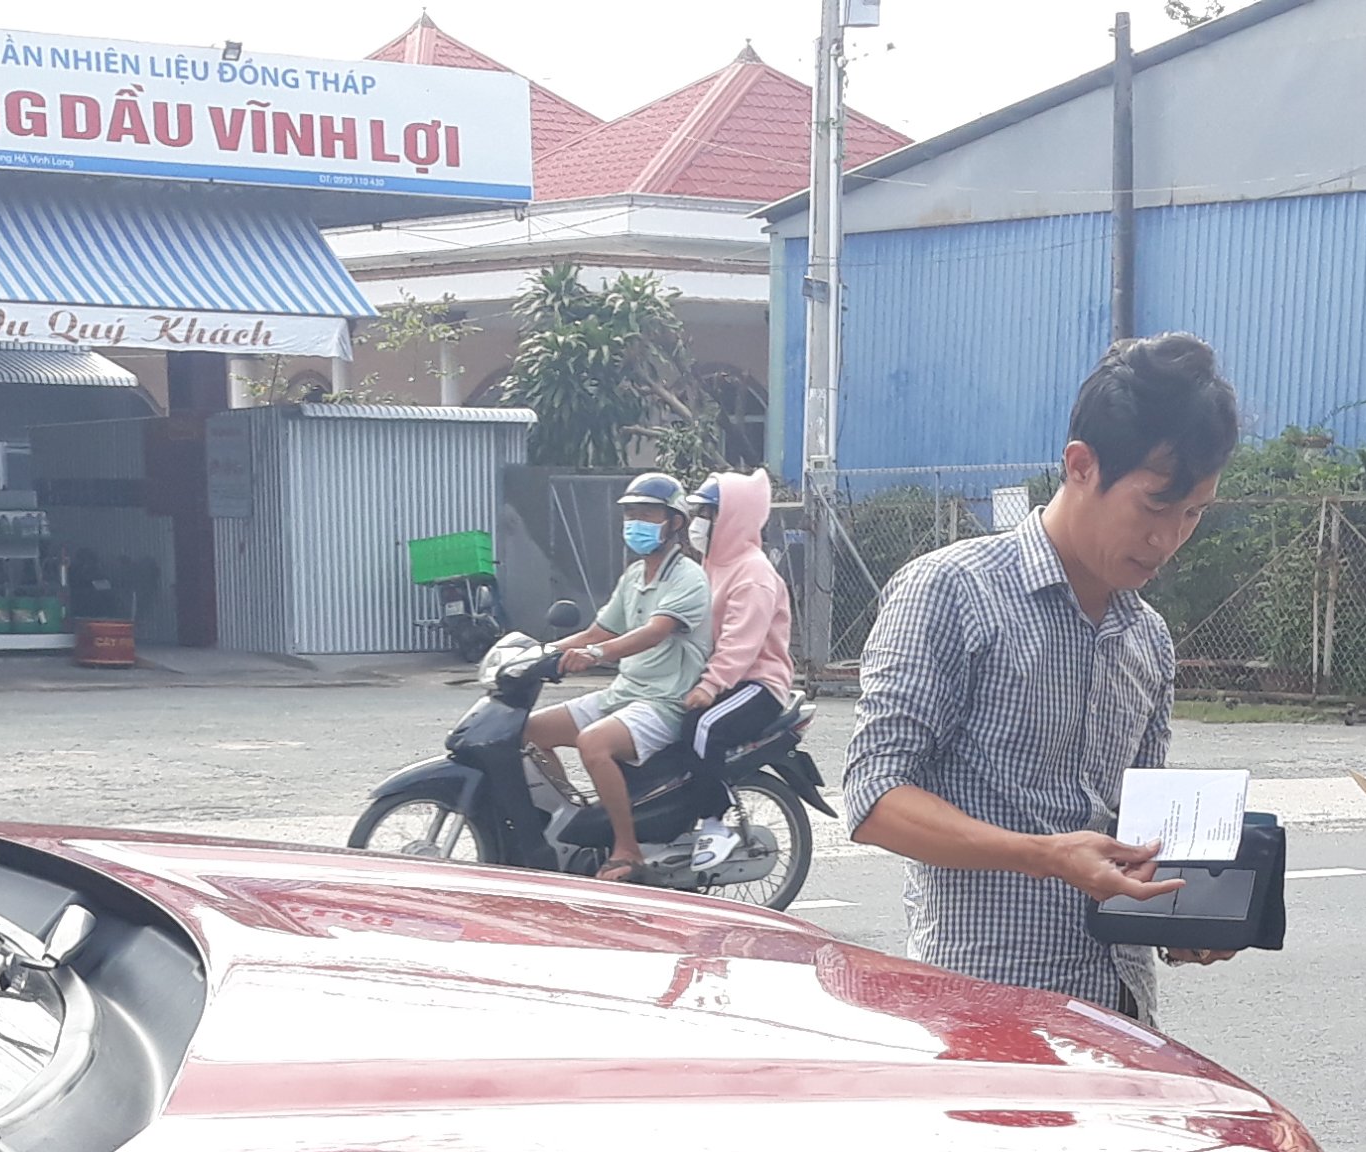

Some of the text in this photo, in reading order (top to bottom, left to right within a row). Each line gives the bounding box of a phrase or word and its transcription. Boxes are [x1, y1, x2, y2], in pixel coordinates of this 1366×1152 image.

[49, 45, 142, 75] NHIÊN
[149, 53, 210, 85] LIỆU
[217, 57, 300, 90] ĐỒNG
[305, 66, 377, 96] THÁP
[60, 83, 195, 148] DẦU
[208, 99, 359, 160] VĨNH
[371, 118, 462, 174] LỢI
[52, 156, 75, 168] Long
[48, 310, 131, 346] Quý
[143, 314, 275, 347] Khách
